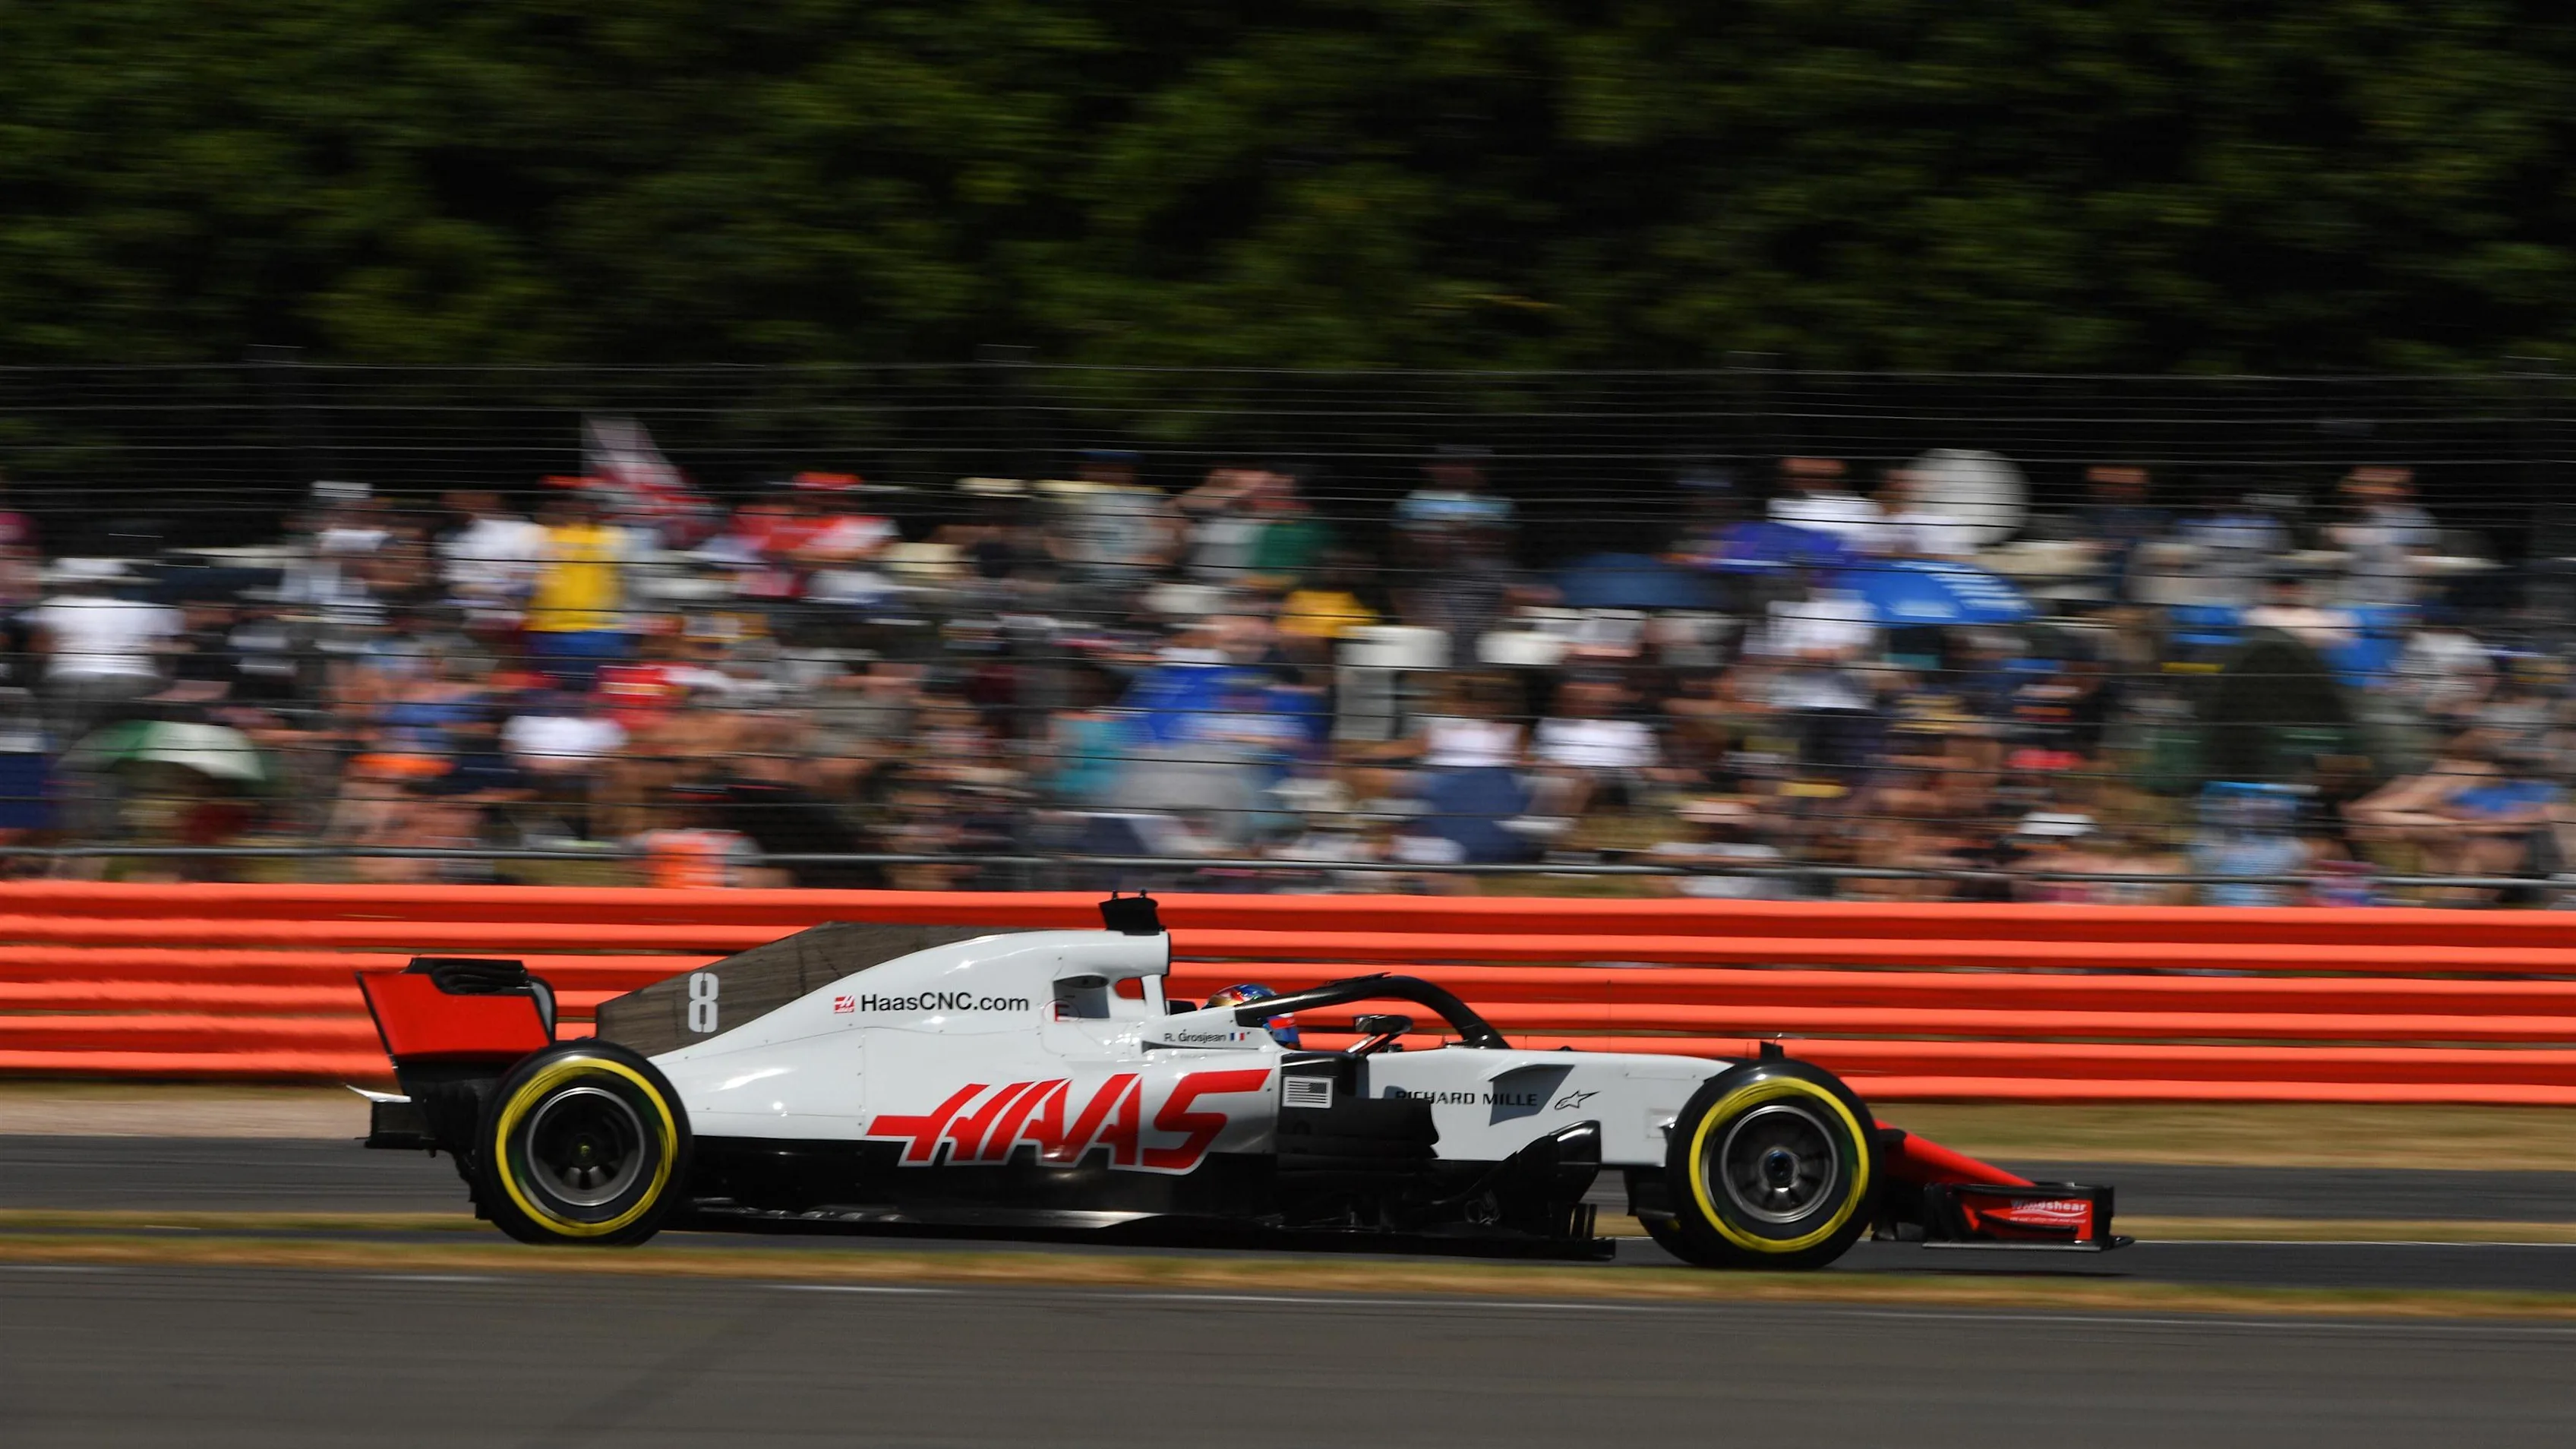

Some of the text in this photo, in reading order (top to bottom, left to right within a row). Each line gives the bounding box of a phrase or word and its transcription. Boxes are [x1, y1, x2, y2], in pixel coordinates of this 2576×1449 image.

[688, 972, 719, 1033] 8
[861, 992, 1029, 1012] HaasCNC.com
[1163, 1032, 1226, 1043] R. Grosjean
[1482, 1093, 1538, 1106] MILLE
[866, 1069, 1271, 1175] HAAS
